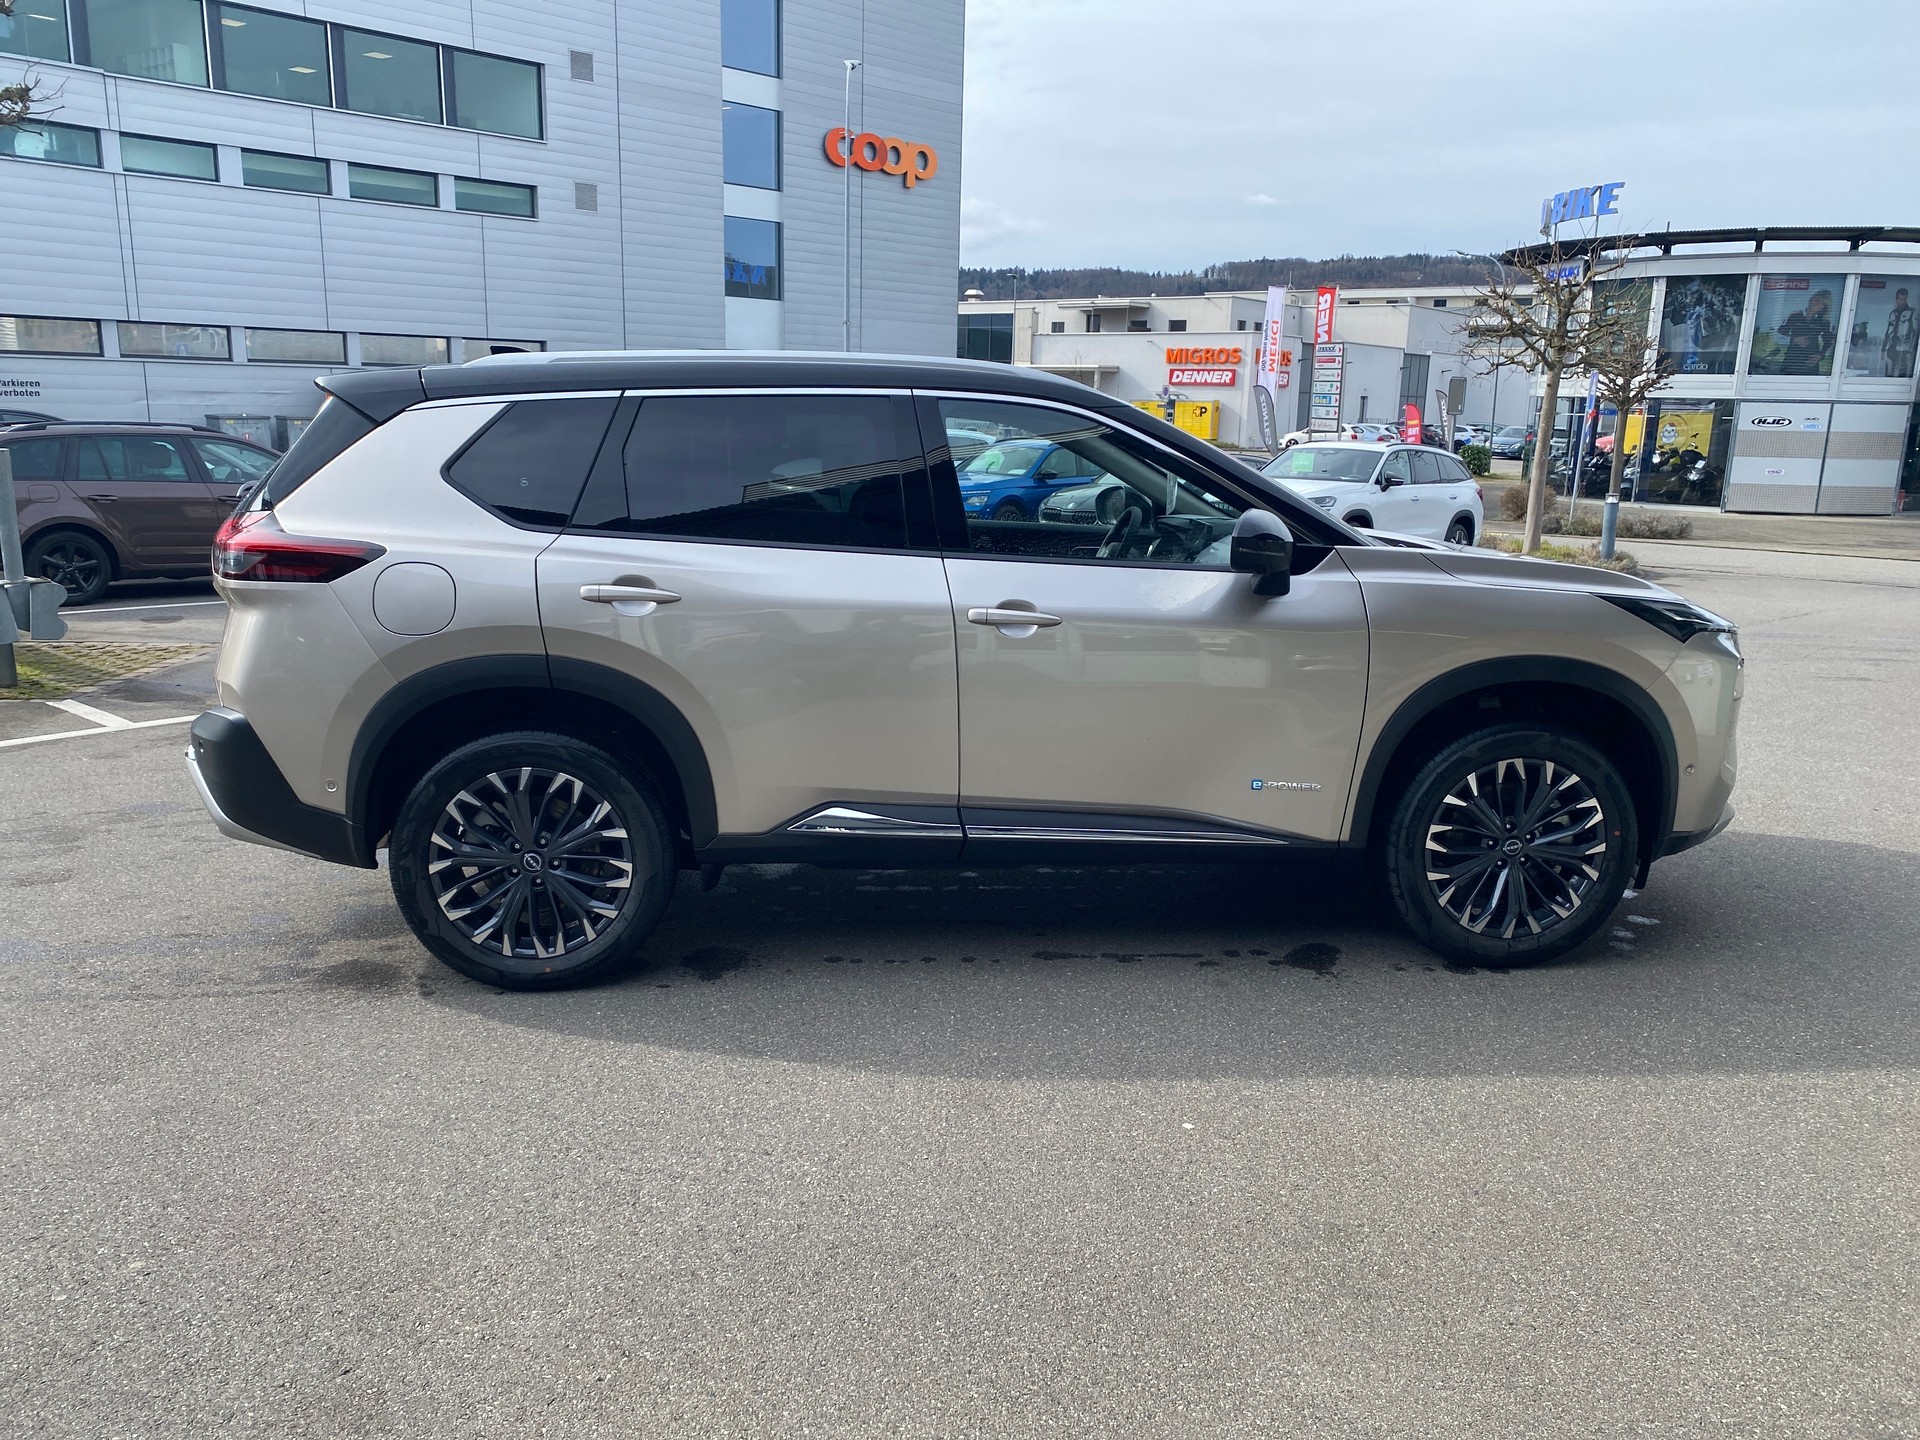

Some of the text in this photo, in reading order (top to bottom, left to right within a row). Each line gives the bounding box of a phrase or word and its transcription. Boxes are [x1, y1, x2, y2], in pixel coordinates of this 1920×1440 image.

[824, 127, 938, 188] coop
[1165, 347, 1242, 365] MIGROS
[1683, 362, 1709, 371] cardo
[1171, 370, 1233, 384] DENNER
[1251, 779, 1322, 792] e-POWER
